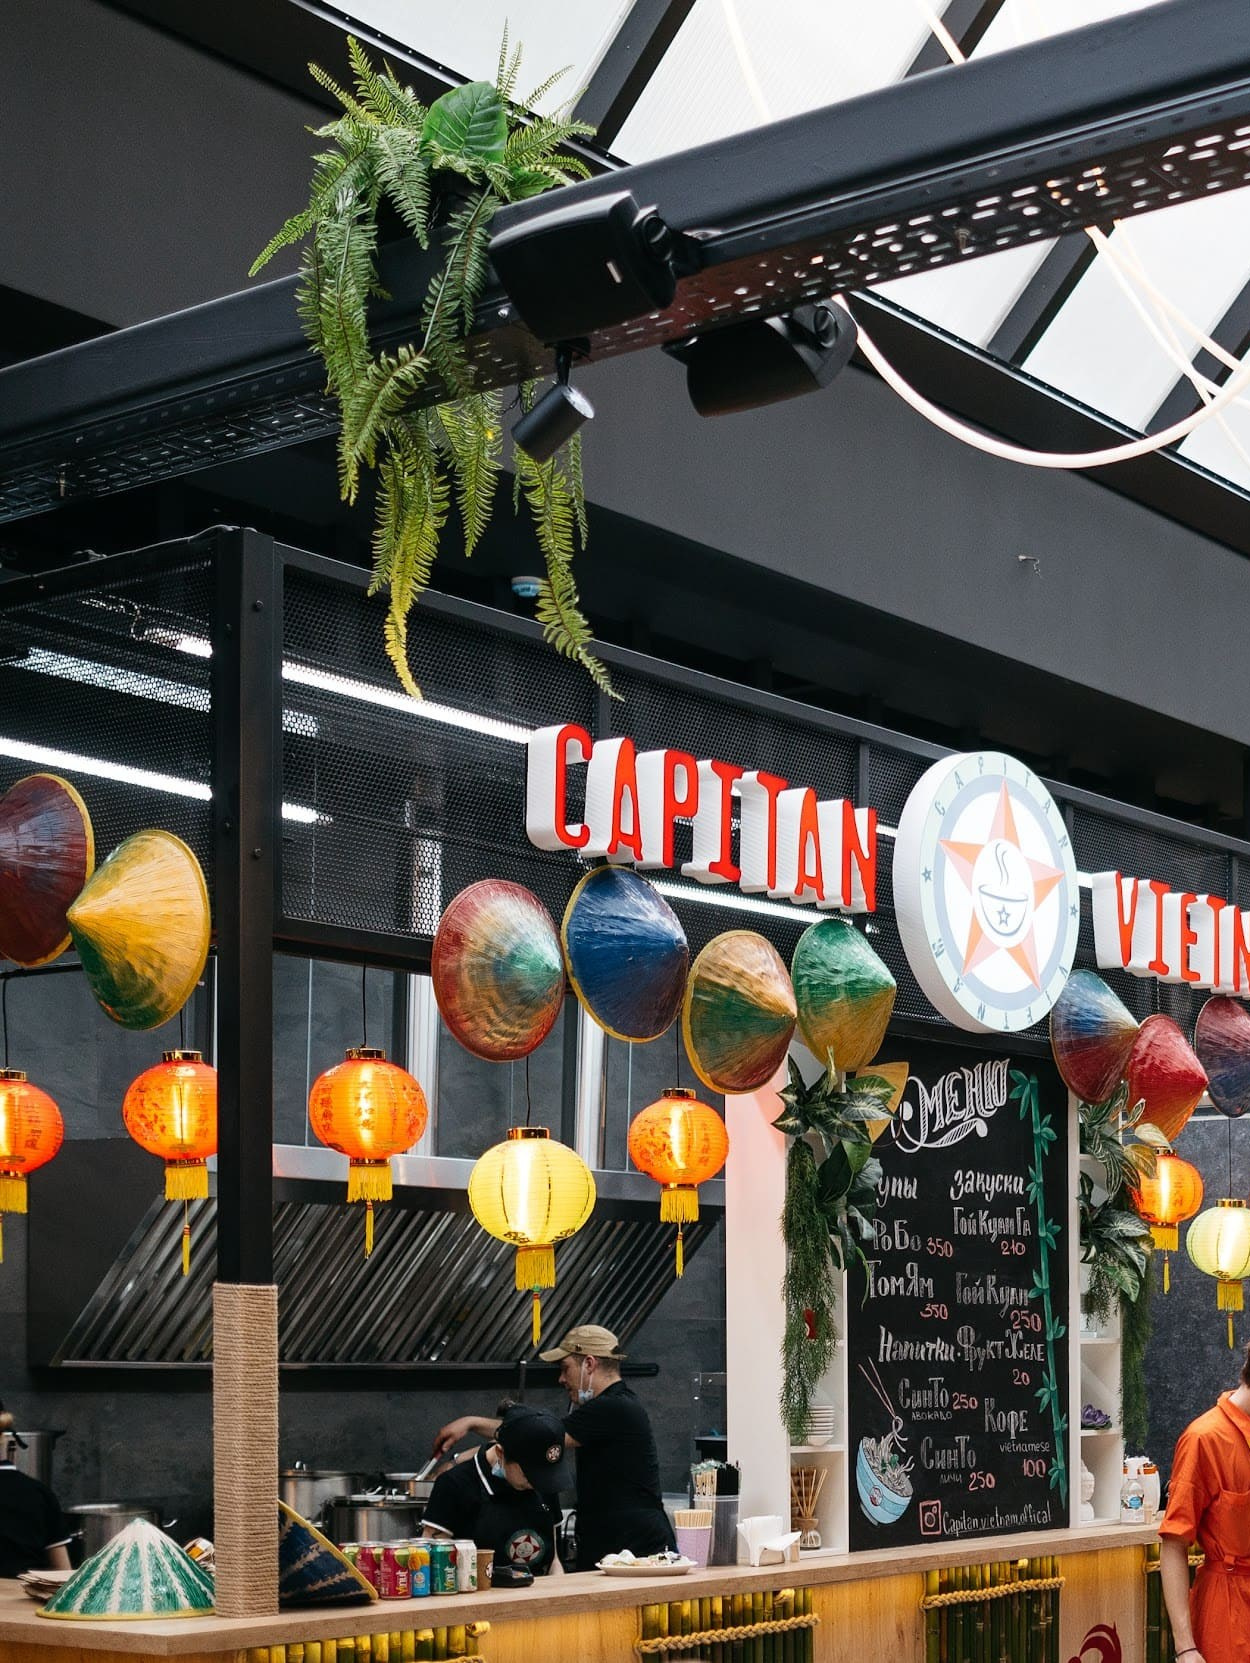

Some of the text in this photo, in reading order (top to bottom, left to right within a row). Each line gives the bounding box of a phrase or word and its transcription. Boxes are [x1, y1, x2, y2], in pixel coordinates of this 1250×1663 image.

[934, 756, 1069, 849] CAPITAN
[548, 722, 878, 913] CAPITAN
[876, 1175, 918, 1208] упы
[926, 1237, 953, 1258] 350
[1001, 1240, 1026, 1256] 210
[920, 1303, 949, 1320] 350
[1010, 1310, 1042, 1332] 250
[878, 1324, 955, 1362] Напитки
[1012, 1368, 1031, 1386] 20
[952, 1392, 978, 1410] 250
[999, 1439, 1050, 1453] vietnamese
[1022, 1458, 1047, 1478] 100
[968, 1470, 996, 1491] 250
